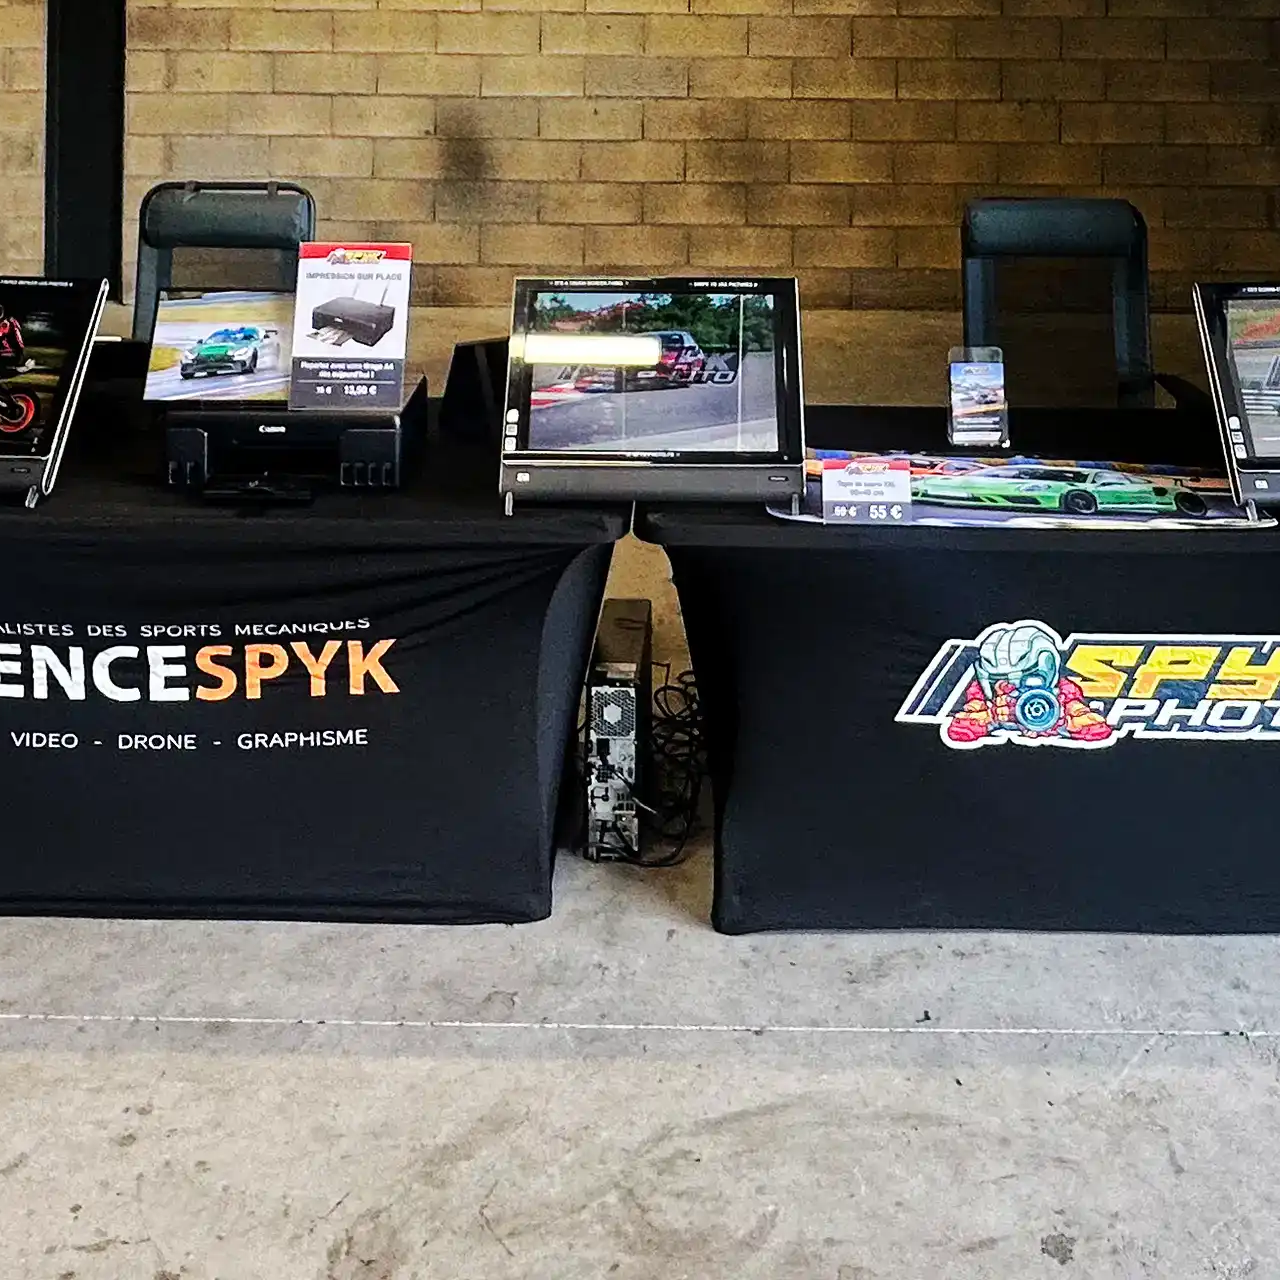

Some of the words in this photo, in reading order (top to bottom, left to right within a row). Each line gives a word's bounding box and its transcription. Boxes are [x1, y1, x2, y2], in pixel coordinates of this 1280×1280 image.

[306, 272, 355, 280] IMPRESSION
[376, 273, 402, 281] PLACE
[870, 504, 887, 519] 55
[890, 504, 903, 519] €
[87, 624, 128, 637] DES
[139, 624, 222, 637] SPORTS
[234, 618, 371, 637] MECANIQUES
[10, 731, 79, 749] VIDEO
[117, 733, 197, 750] DRONE
[237, 728, 369, 750] GRAPHISME
